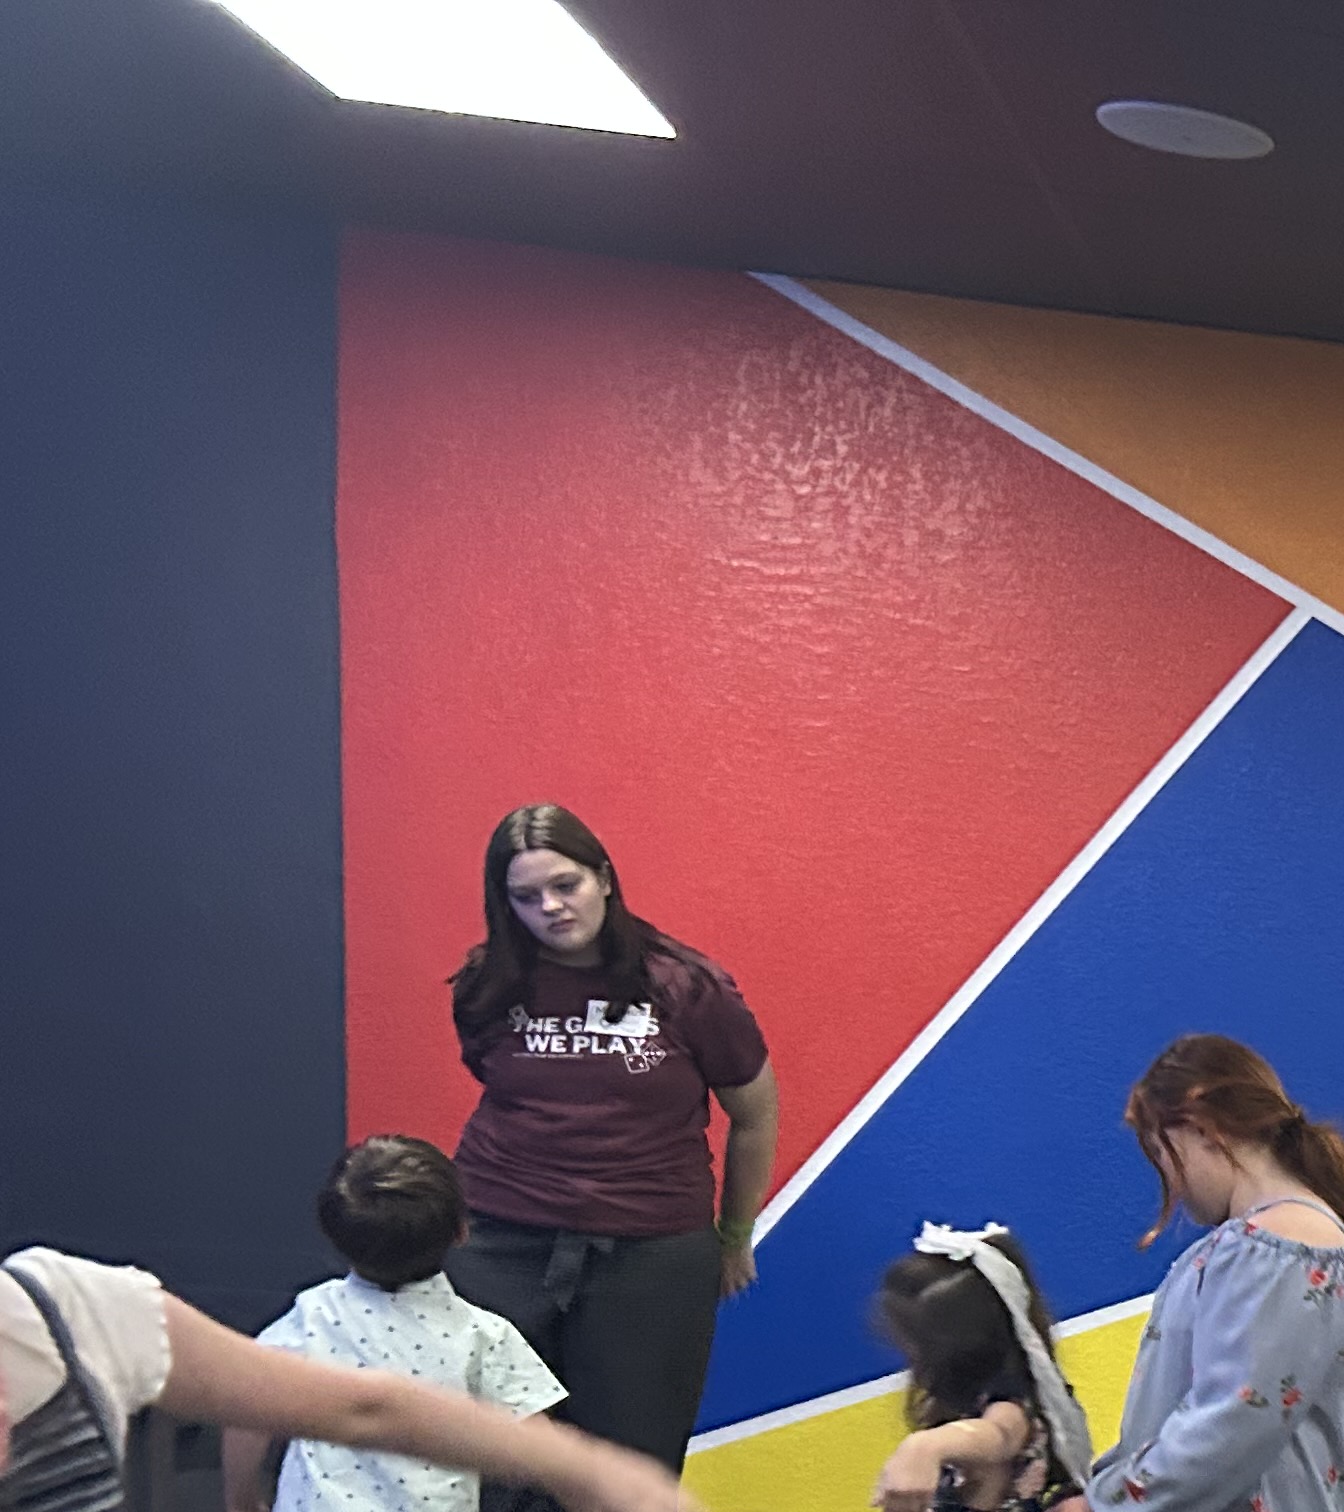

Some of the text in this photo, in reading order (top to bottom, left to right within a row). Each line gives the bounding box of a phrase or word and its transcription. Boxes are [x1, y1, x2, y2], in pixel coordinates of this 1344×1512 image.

[522, 1015, 560, 1034] HE
[525, 1033, 646, 1055] WE PLAY
